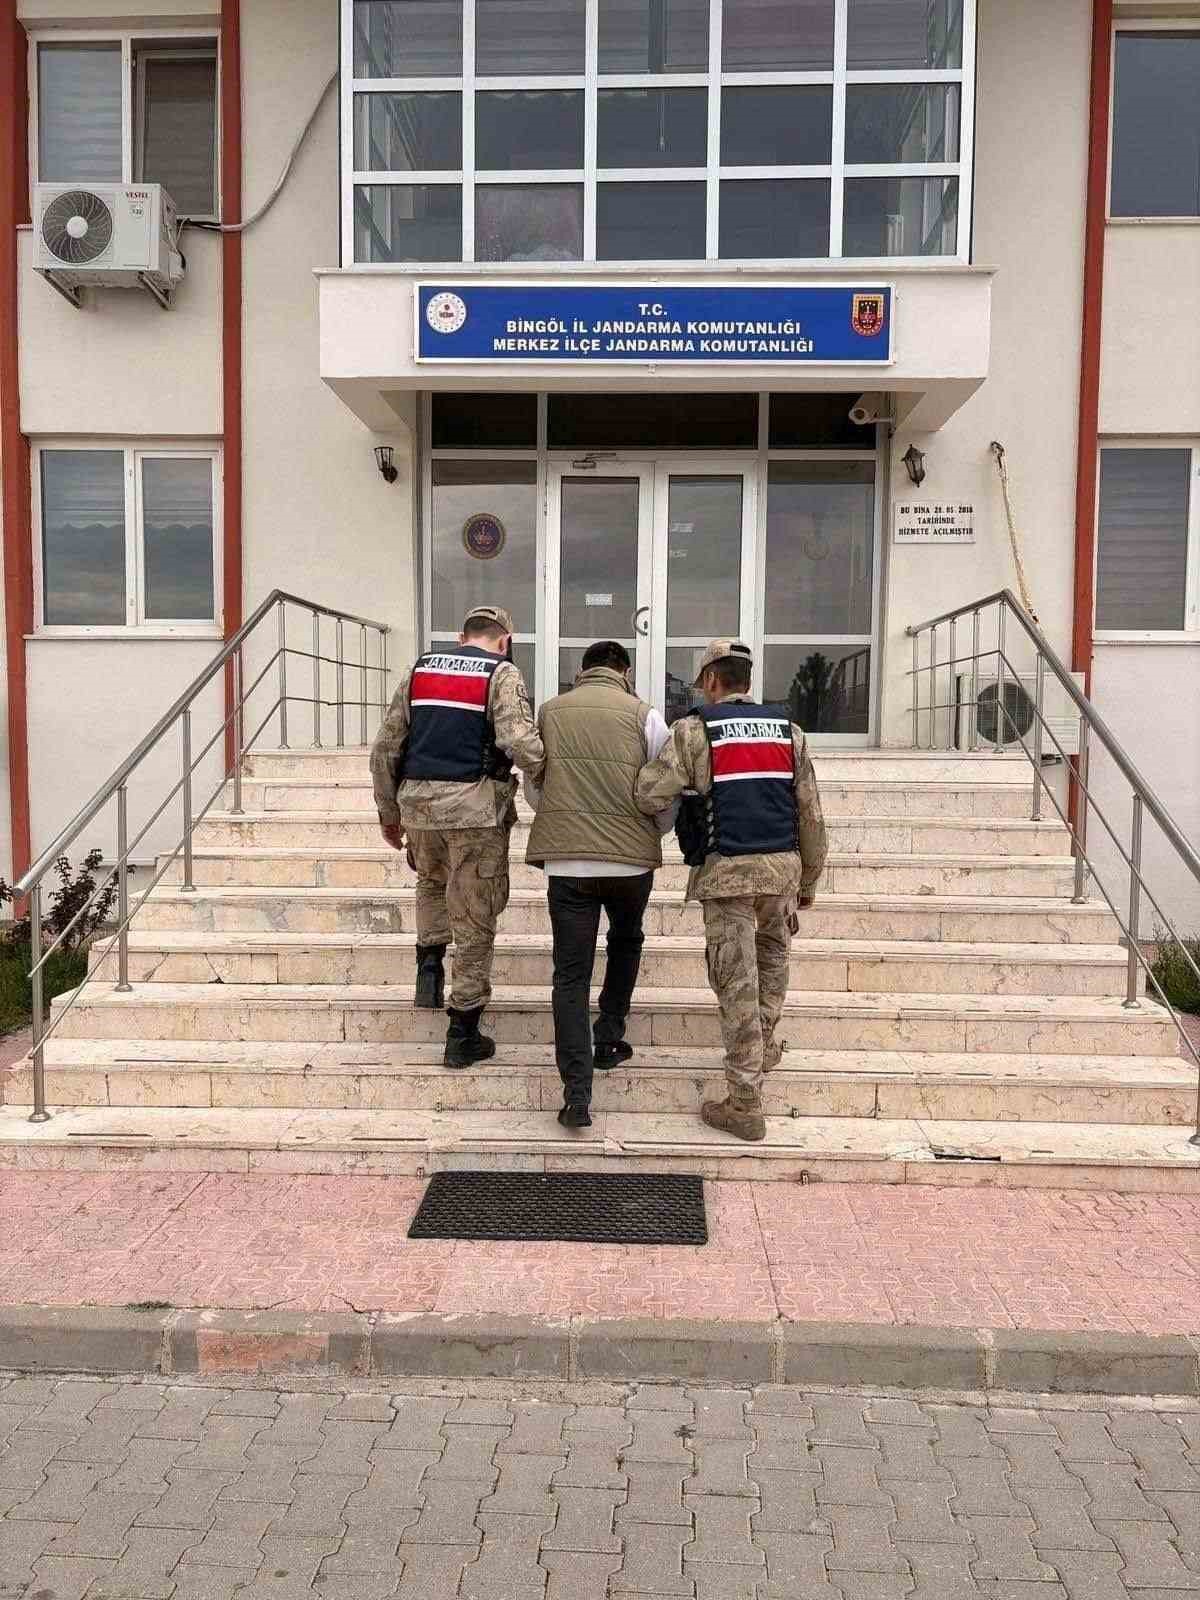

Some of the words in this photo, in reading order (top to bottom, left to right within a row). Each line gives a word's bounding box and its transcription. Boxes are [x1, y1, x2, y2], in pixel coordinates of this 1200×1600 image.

[638, 303, 667, 316] T.C.
[506, 317, 567, 333] BİNGÖL
[573, 318, 588, 333] İL
[593, 320, 682, 334] JANDARMA
[687, 319, 801, 334] KOMUTANLIĞI
[493, 338, 559, 351] MERKEZ
[565, 336, 601, 354] İLÇE
[606, 339, 695, 352] JANDARMA
[700, 337, 813, 352] KOMUTANLIĞI
[900, 506, 910, 514] BU
[423, 656, 486, 672] JANDARMA
[719, 722, 784, 738] JANDARMA
